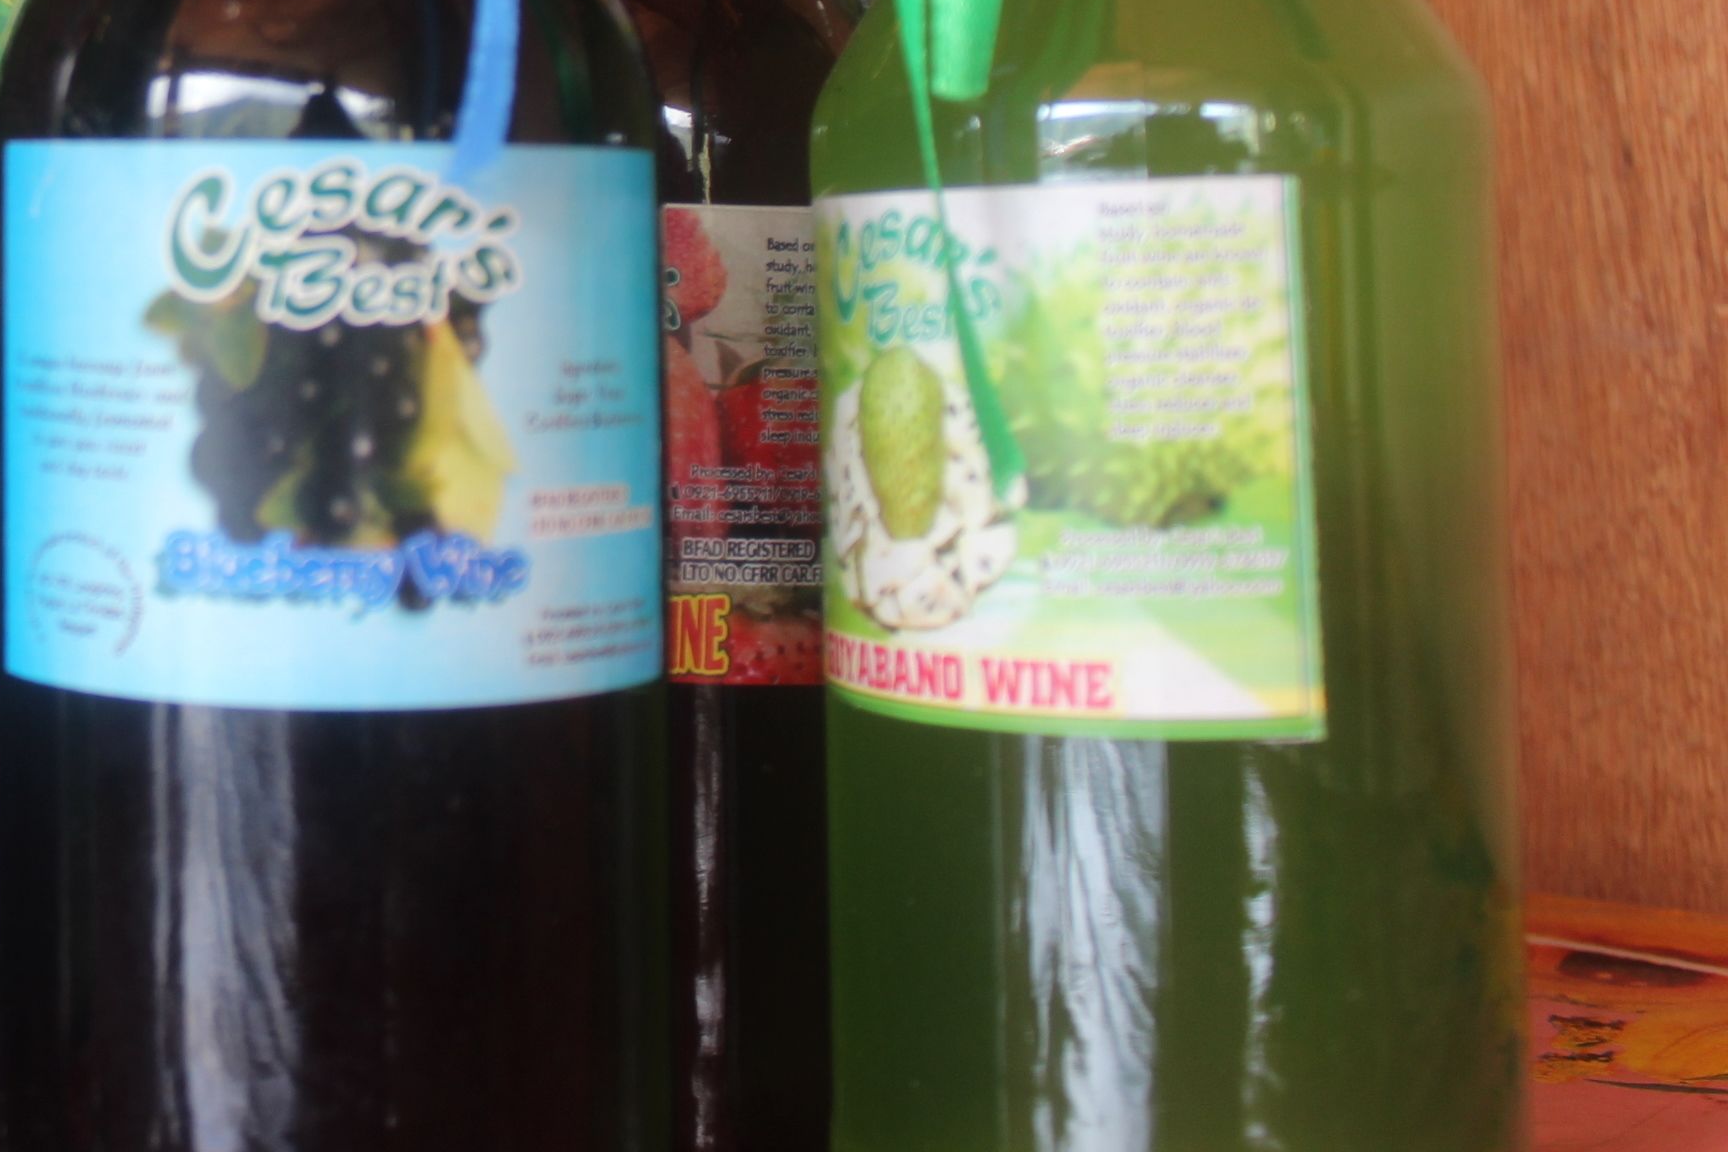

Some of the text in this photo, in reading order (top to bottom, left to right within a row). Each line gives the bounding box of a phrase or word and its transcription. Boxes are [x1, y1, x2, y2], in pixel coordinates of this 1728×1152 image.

[171, 157, 522, 303] Cesar's
[766, 237, 799, 252] Based
[256, 233, 452, 331] Best
[782, 303, 815, 317] conta
[682, 538, 816, 561] BFAD REGISTERED
[681, 563, 710, 583] LTO
[669, 594, 731, 676] INE
[980, 656, 1112, 709] WINE
